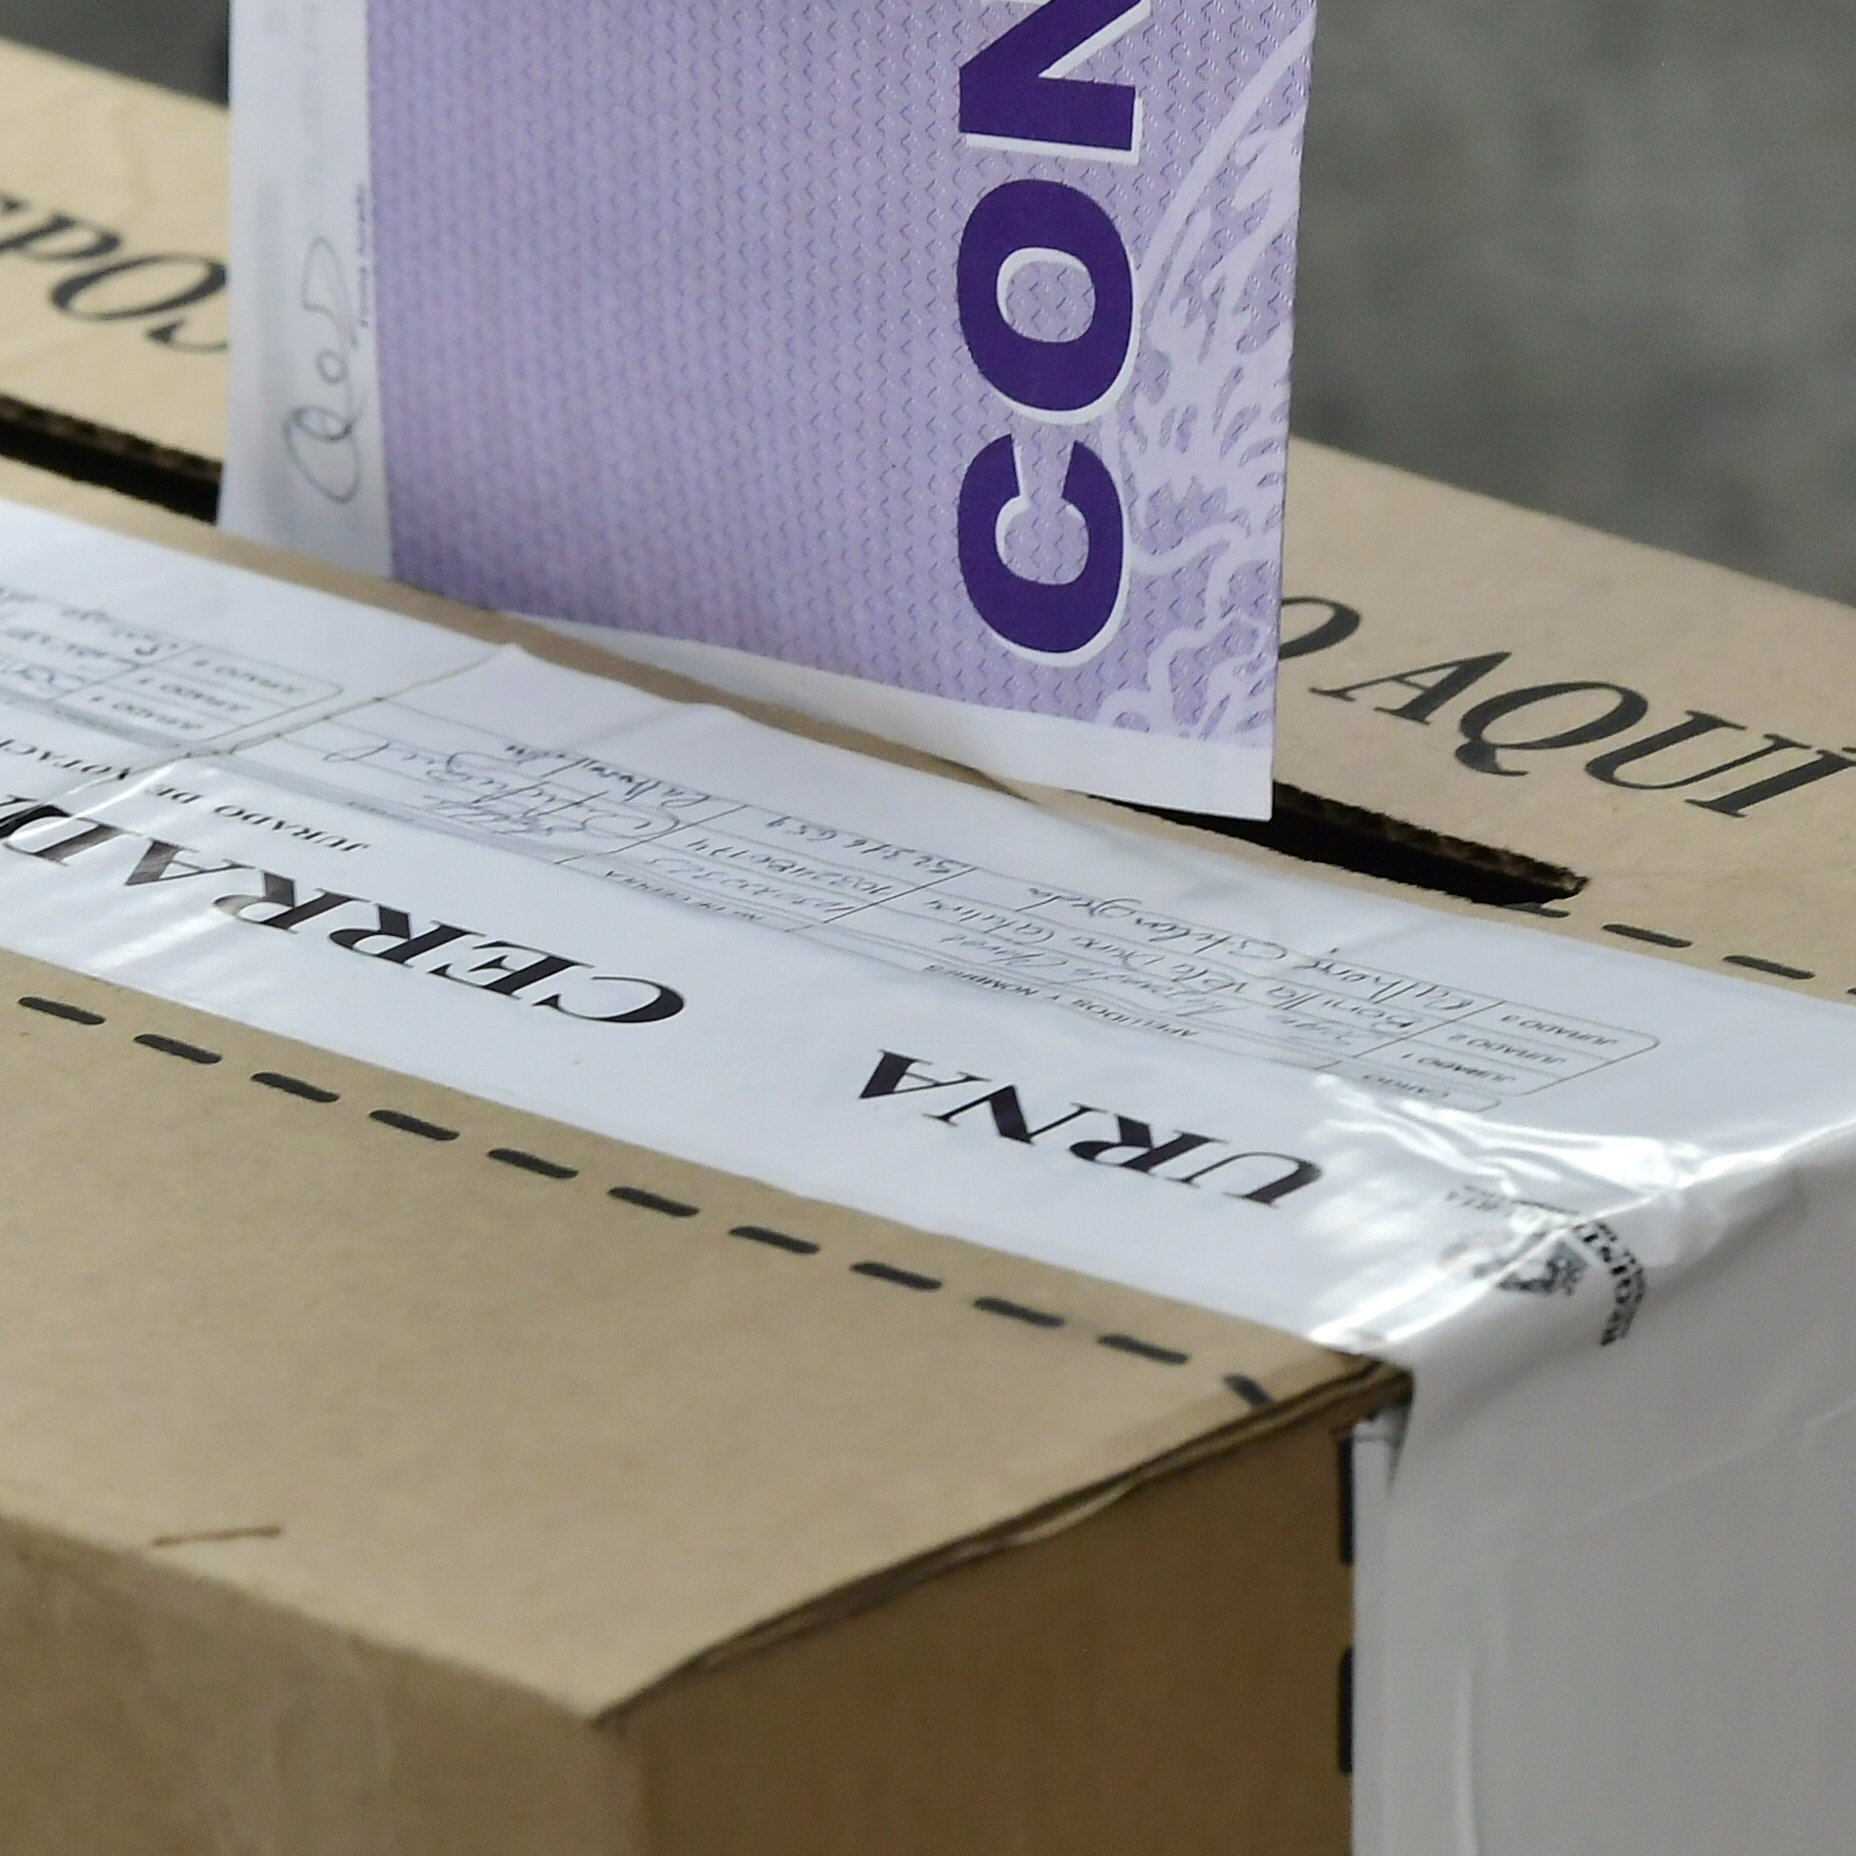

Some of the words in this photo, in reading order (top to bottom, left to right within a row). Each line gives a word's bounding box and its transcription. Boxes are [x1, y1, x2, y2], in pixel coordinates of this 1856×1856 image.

[154, 785, 204, 805] DE
[212, 800, 371, 854] JURADO
[1519, 1020, 1618, 1045] JURADO
[1466, 1039, 1566, 1064] JURADO
[859, 1050, 1321, 1206] URNA
